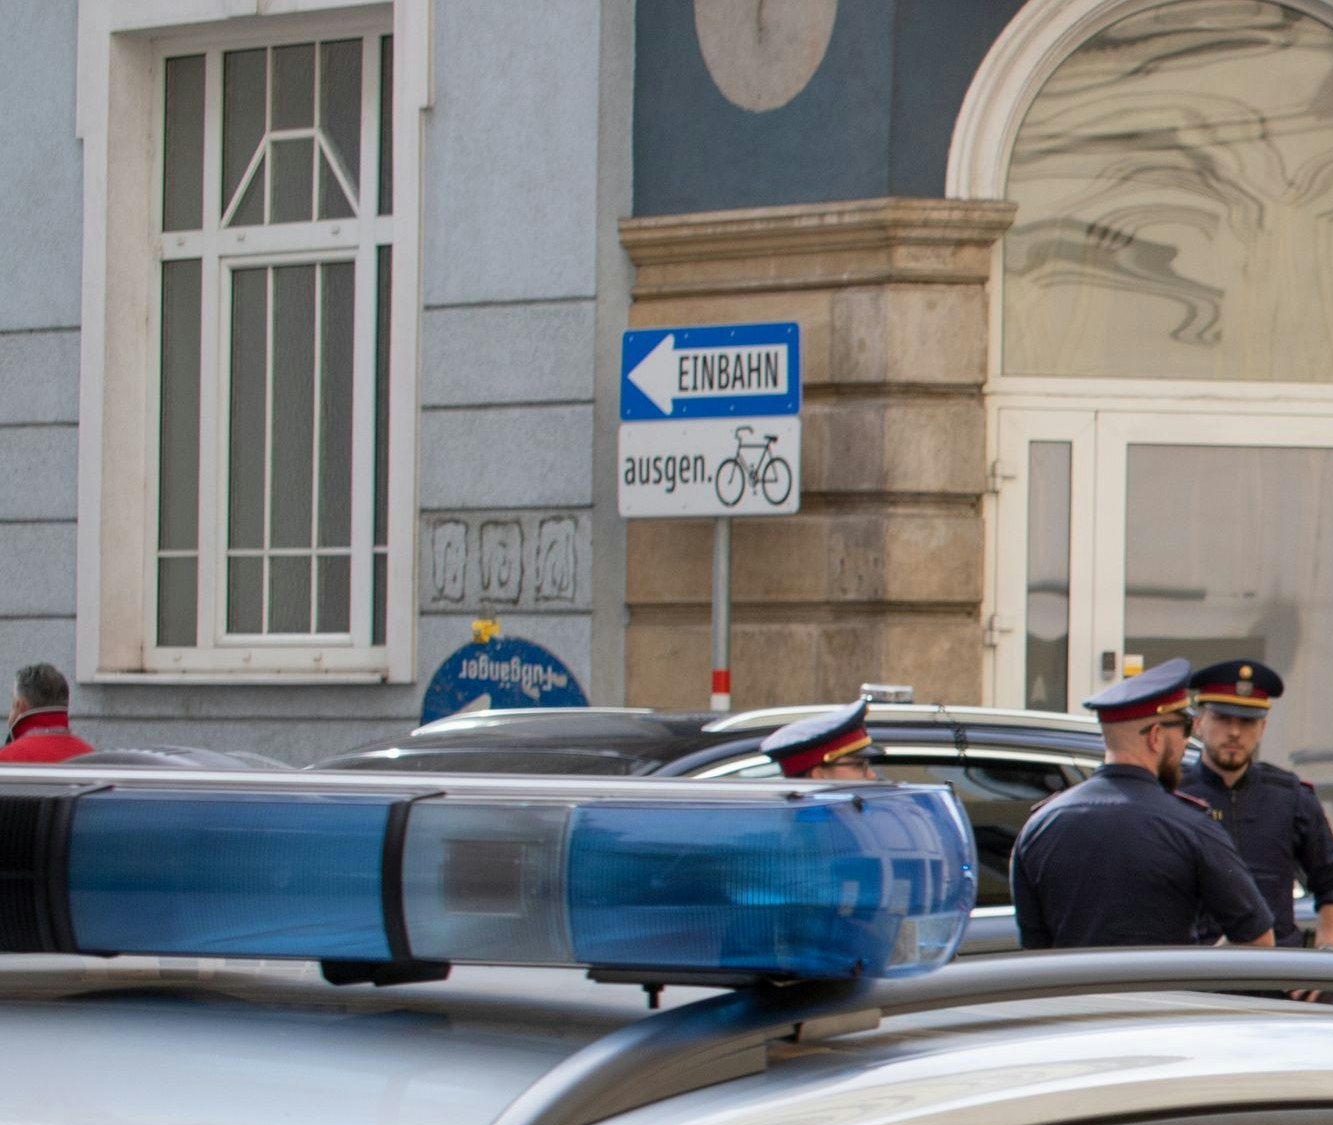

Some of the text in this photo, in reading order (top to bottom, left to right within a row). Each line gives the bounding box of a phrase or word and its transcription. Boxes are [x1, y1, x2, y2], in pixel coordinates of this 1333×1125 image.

[677, 351, 780, 392] EINBAHN
[624, 453, 713, 493] ausgen.
[457, 654, 554, 692] Fußgänger
